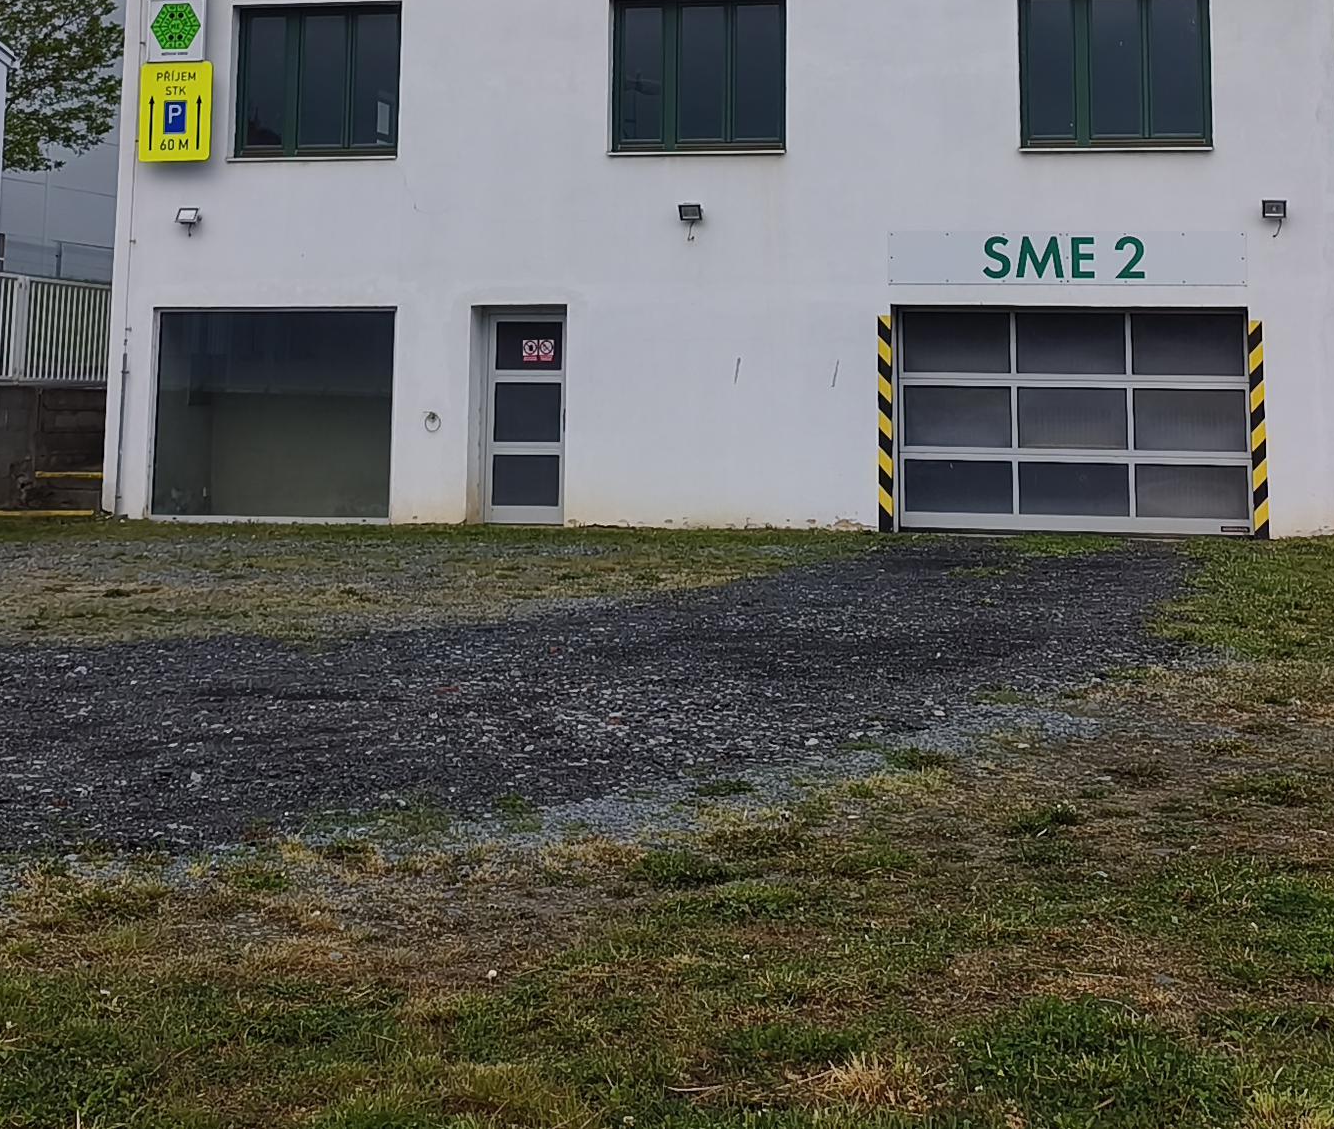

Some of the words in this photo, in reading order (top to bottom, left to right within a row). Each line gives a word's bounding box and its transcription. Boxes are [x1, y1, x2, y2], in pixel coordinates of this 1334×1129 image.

[156, 70, 197, 82] PŘÍJEM
[165, 86, 187, 96] STK
[168, 104, 183, 124] P
[160, 139, 175, 151] 60
[178, 139, 189, 151] M
[982, 235, 1095, 280] SME
[1114, 235, 1146, 280] 2
